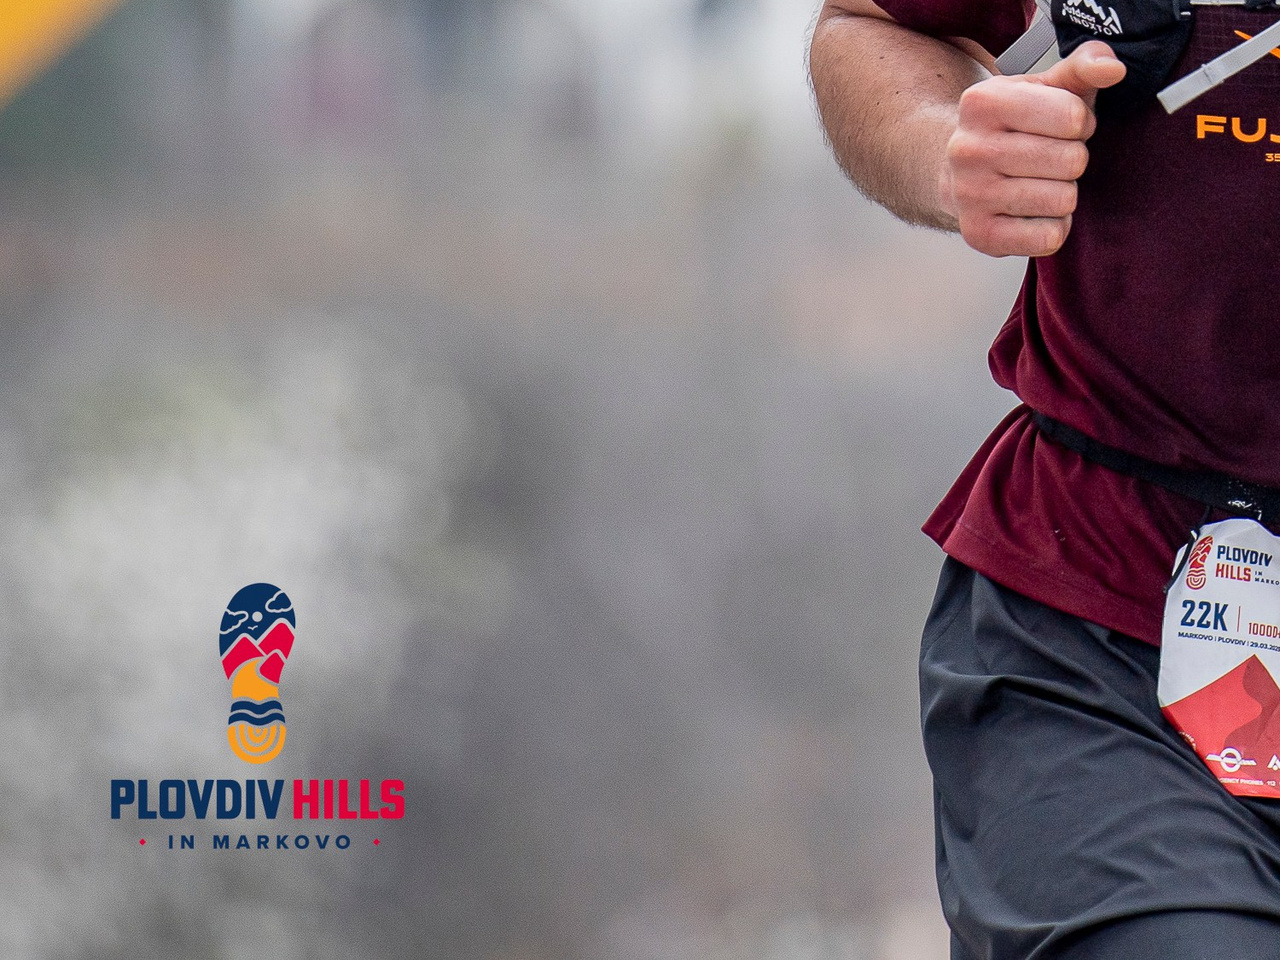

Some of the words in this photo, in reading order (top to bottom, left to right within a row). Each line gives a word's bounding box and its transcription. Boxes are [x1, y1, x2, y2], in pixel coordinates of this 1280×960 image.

[1217, 545, 1273, 567] PLOVDIV
[1215, 563, 1252, 582] HILLS
[1180, 599, 1229, 632] 22K
[1178, 631, 1213, 641] MARKOVO
[1218, 636, 1246, 646] PLOVDIV
